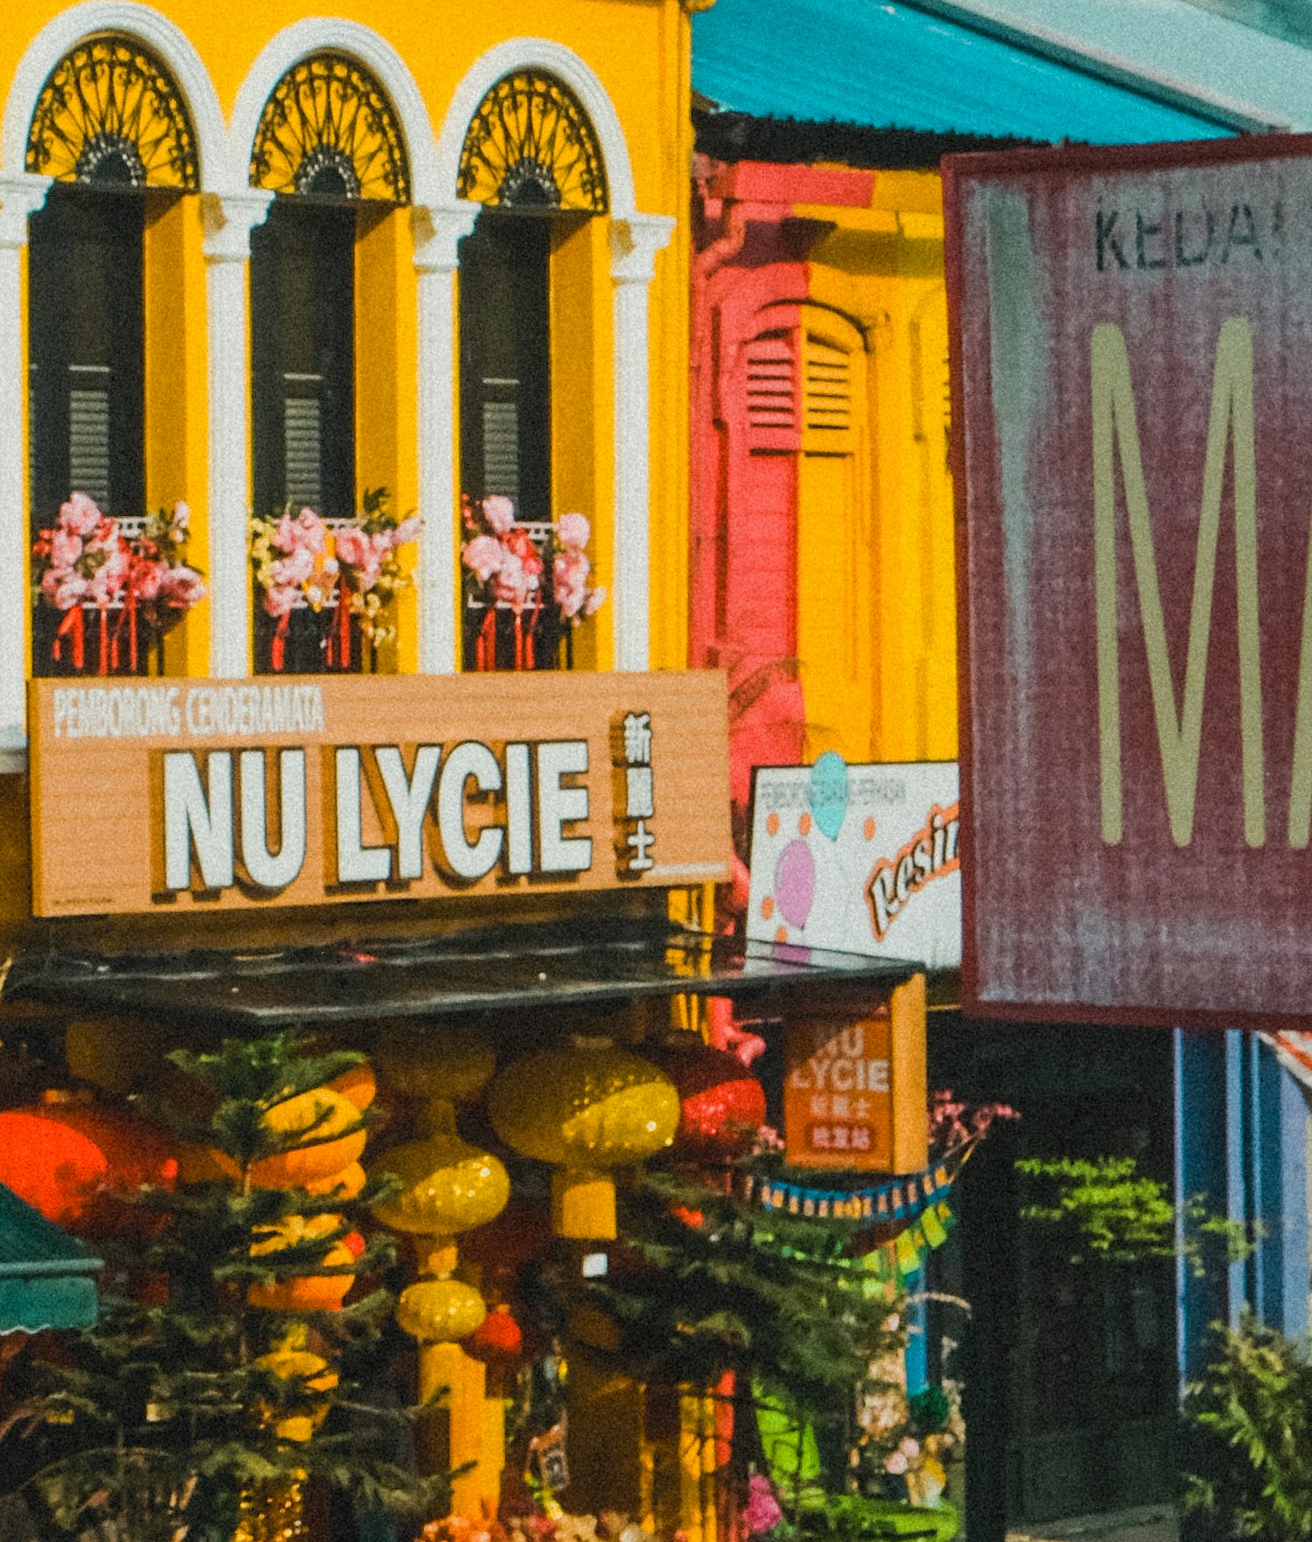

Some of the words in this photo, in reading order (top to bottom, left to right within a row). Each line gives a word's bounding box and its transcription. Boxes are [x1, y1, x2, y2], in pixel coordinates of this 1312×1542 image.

[1090, 316, 1312, 849] M
[164, 747, 307, 890] NU
[333, 740, 593, 884] LYCIE
[791, 1058, 890, 1093] LYCIE
